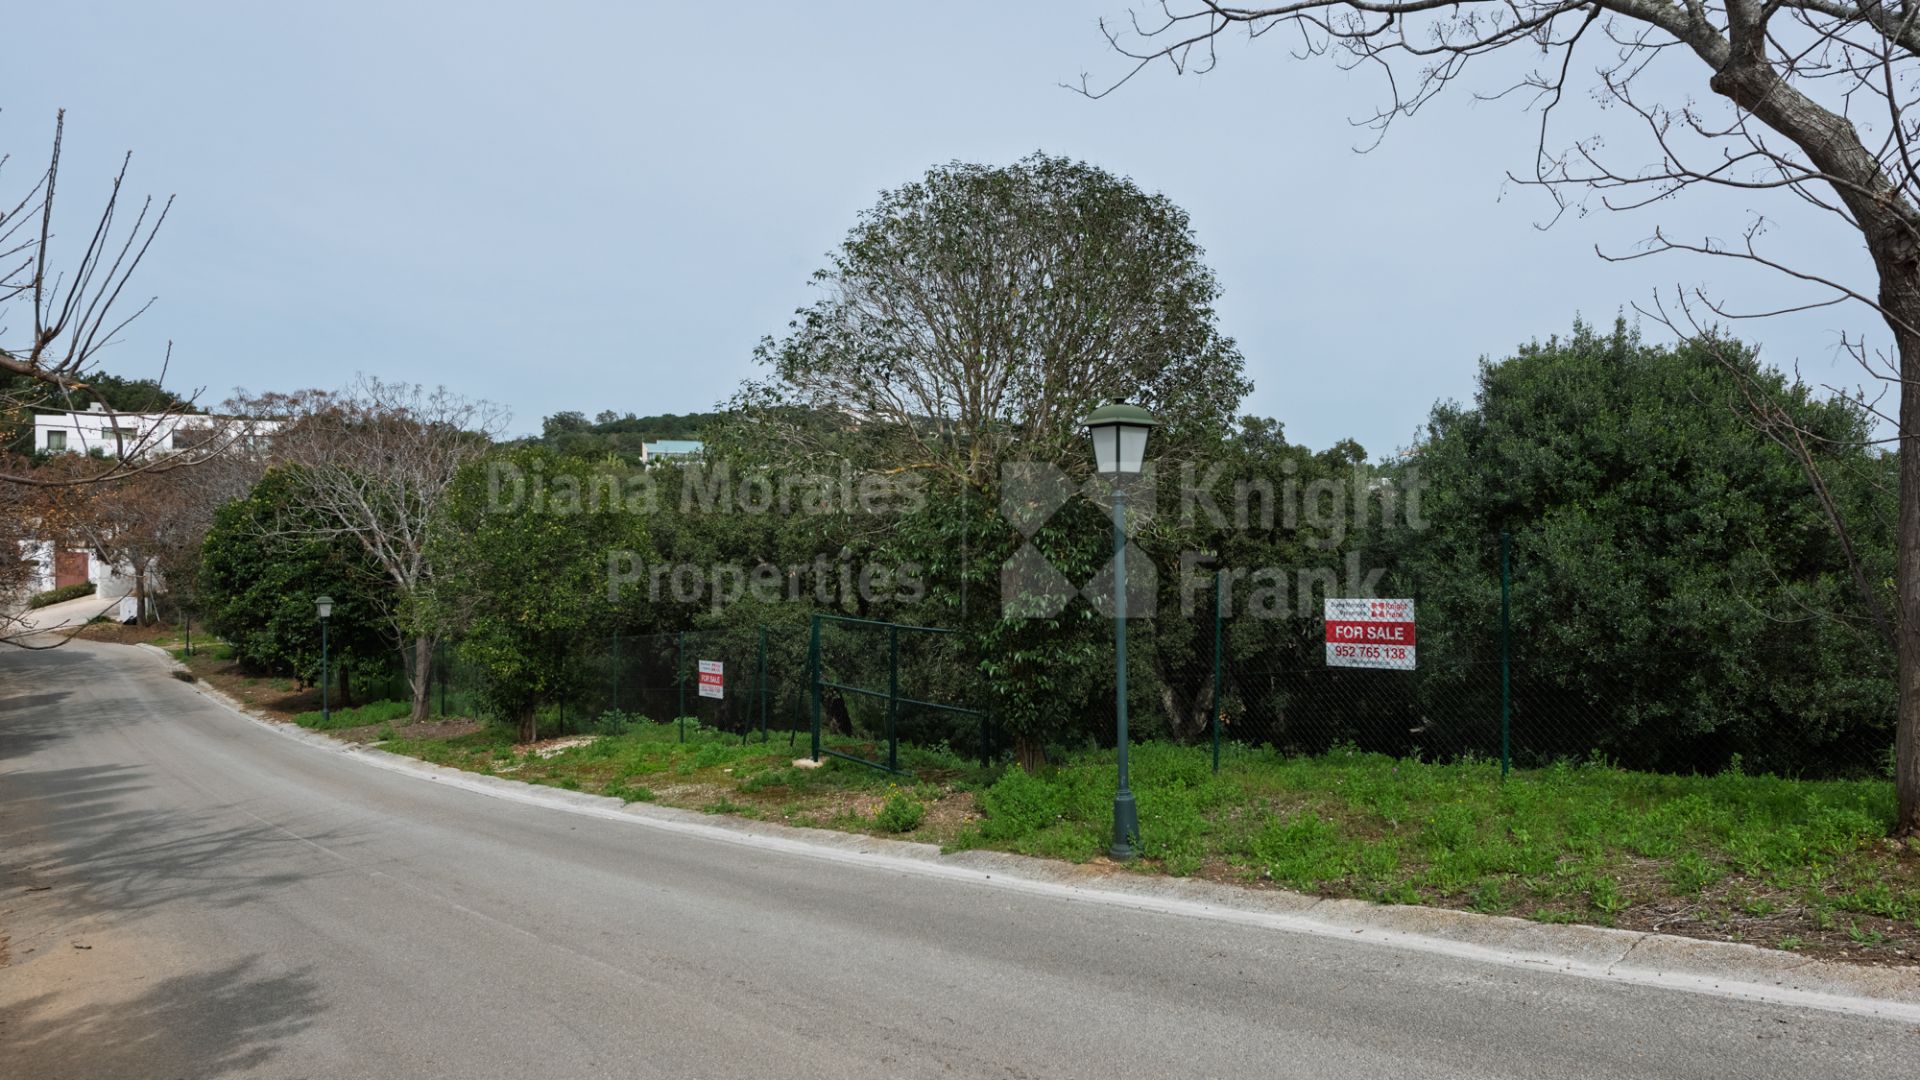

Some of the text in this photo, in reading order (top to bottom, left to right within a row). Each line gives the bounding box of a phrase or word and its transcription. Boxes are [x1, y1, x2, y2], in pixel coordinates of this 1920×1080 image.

[1335, 625, 1404, 640] FOR SALE
[1335, 645, 1406, 660] 952 765 138
[710, 675, 721, 684] SALE
